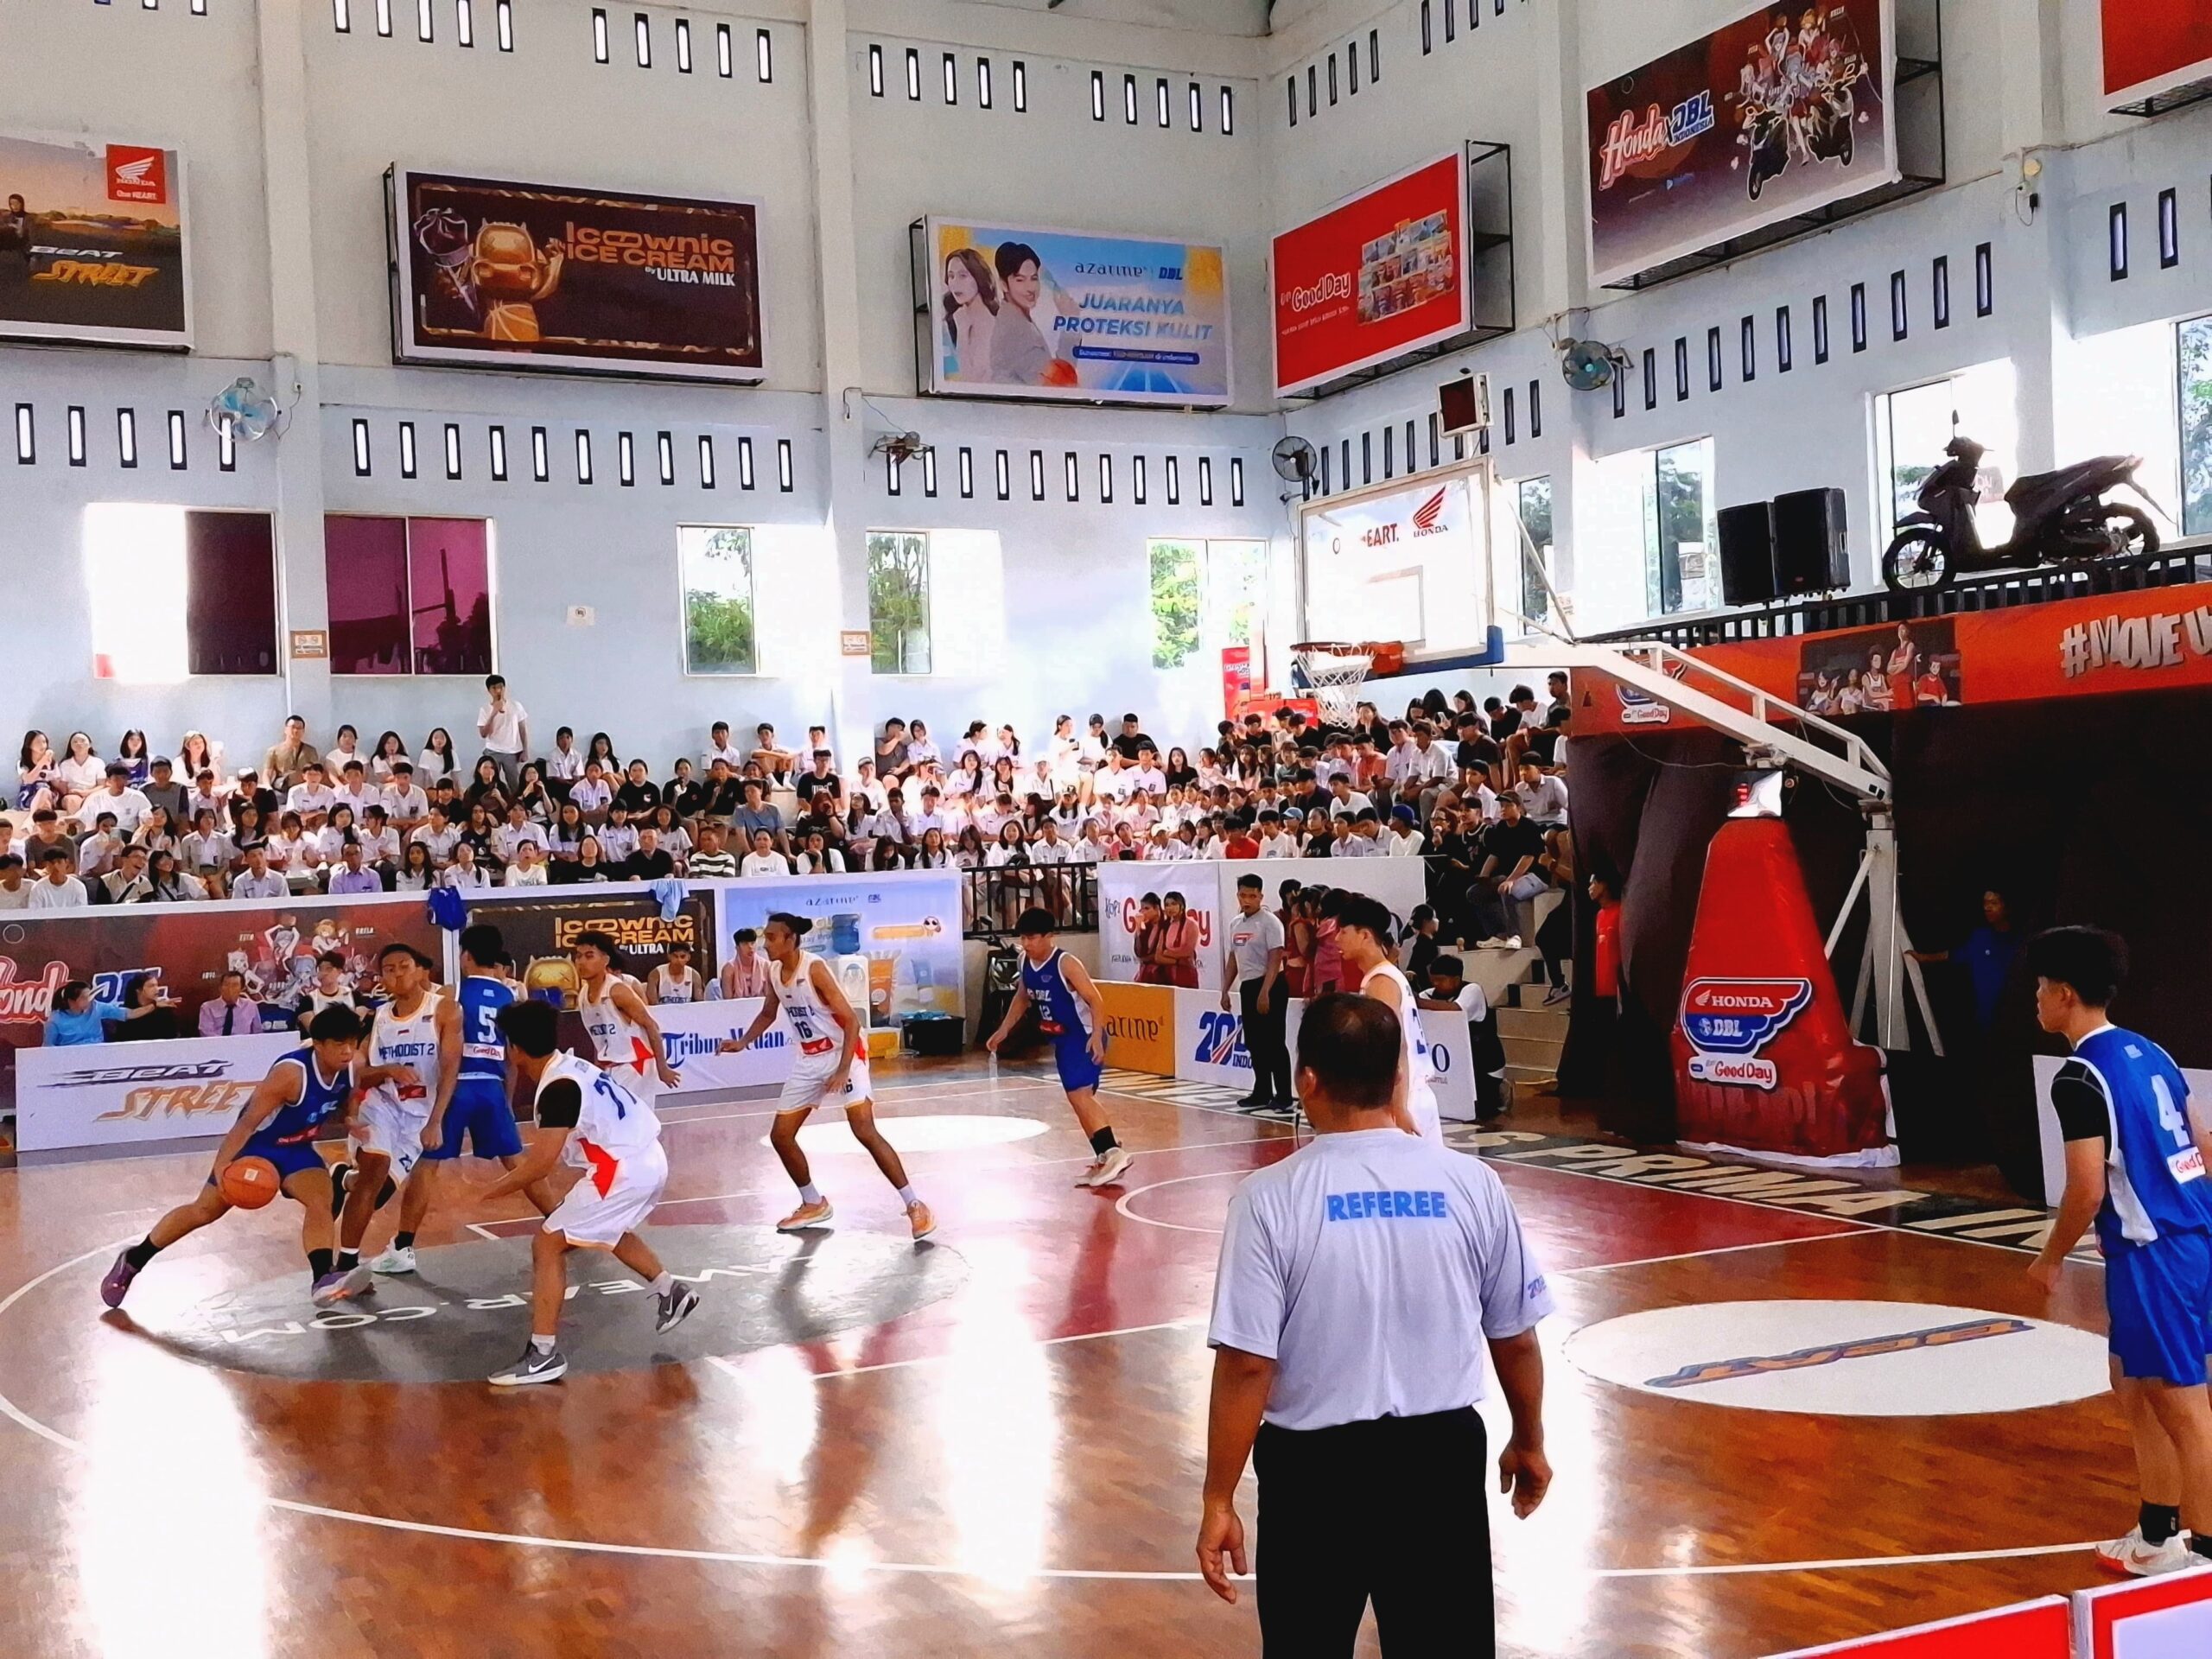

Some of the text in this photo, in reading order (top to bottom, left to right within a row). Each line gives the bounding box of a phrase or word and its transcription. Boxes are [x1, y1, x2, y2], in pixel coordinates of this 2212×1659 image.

[1600, 105, 1667, 185] Honda
[567, 240, 735, 274] ICE CREAM
[32, 260, 160, 288] STREET
[656, 268, 699, 285] ULTRA
[702, 271, 736, 287] MILK
[1078, 293, 1185, 315] JUARANYA
[1052, 315, 1213, 340] PROTEKSI KULIT
[1413, 524, 1449, 538] HONDA
[629, 943, 664, 955] ULTRA
[1712, 995, 1774, 1007] HONDA
[477, 1004, 498, 1044] 5
[794, 1020, 814, 1039] 16
[1713, 1019, 1744, 1038] DBL
[427, 1042, 435, 1056] 2
[92, 1079, 270, 1123] STREE
[2151, 1074, 2190, 1148] 4
[1495, 1143, 1933, 1217] PRIMA
[1326, 1191, 1447, 1222] REFEREE
